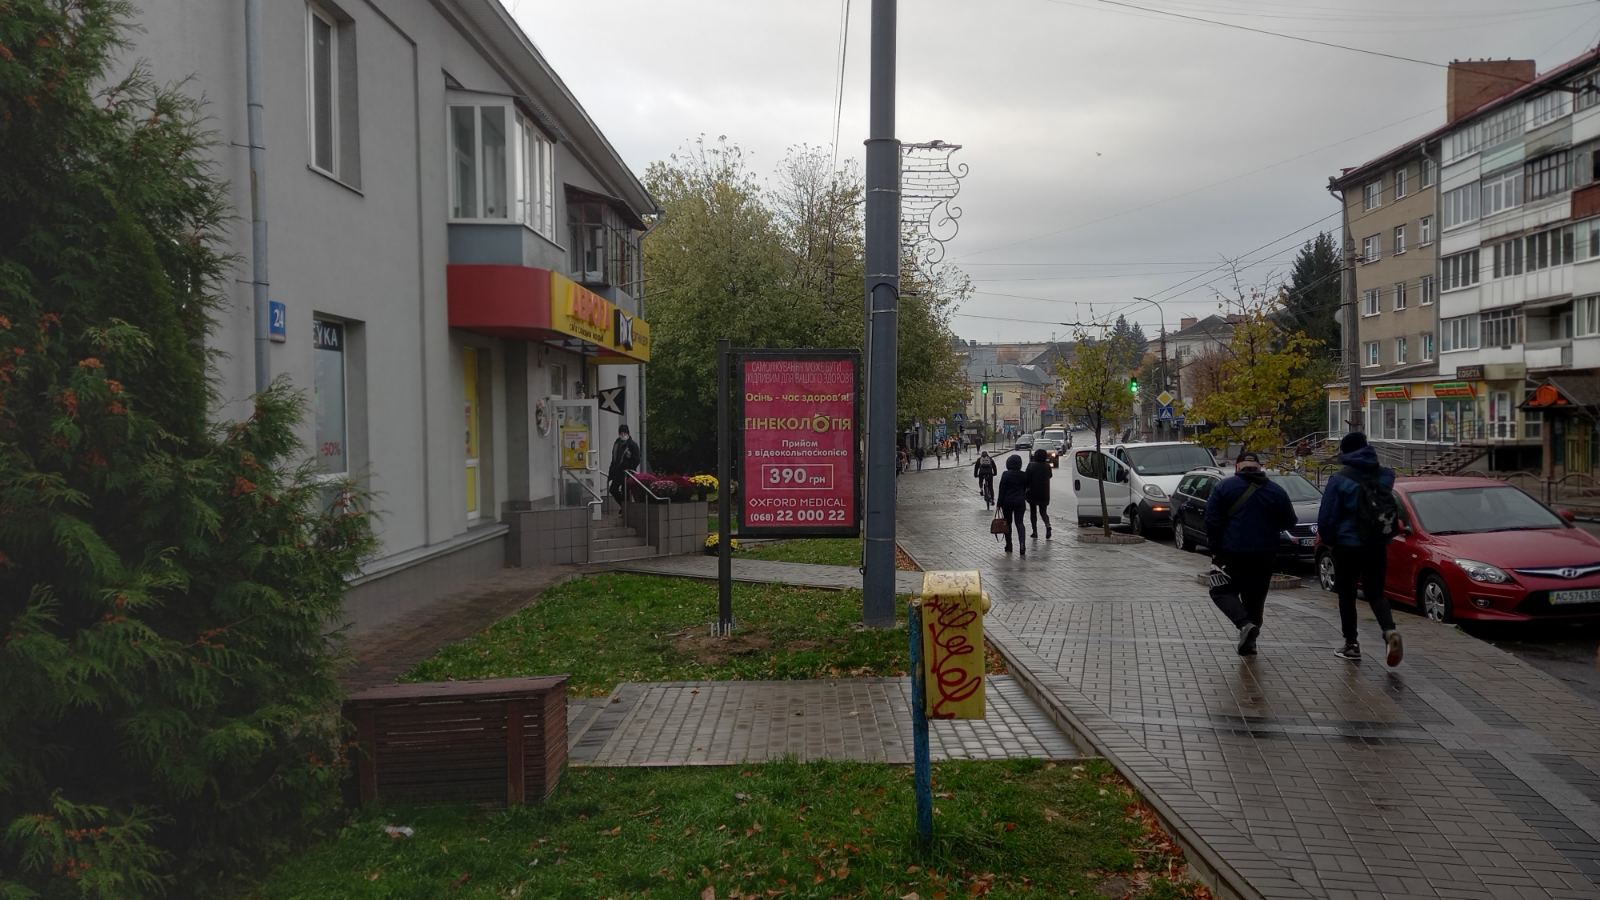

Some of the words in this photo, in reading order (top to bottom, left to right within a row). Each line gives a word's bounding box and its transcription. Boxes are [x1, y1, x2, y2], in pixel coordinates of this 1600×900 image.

[745, 392, 773, 402] Осінь
[782, 394, 799, 402] час
[745, 415, 851, 433] ГІНЕКОЛОГІЯ
[782, 440, 818, 449] Прийом
[769, 468, 807, 484] 390
[809, 476, 825, 485] грн
[749, 498, 796, 507] OXFORD
[800, 498, 846, 507] MEDICAL
[750, 512, 774, 522] (068)
[776, 510, 793, 521] 22
[797, 510, 824, 521] 000
[828, 510, 845, 521] 22
